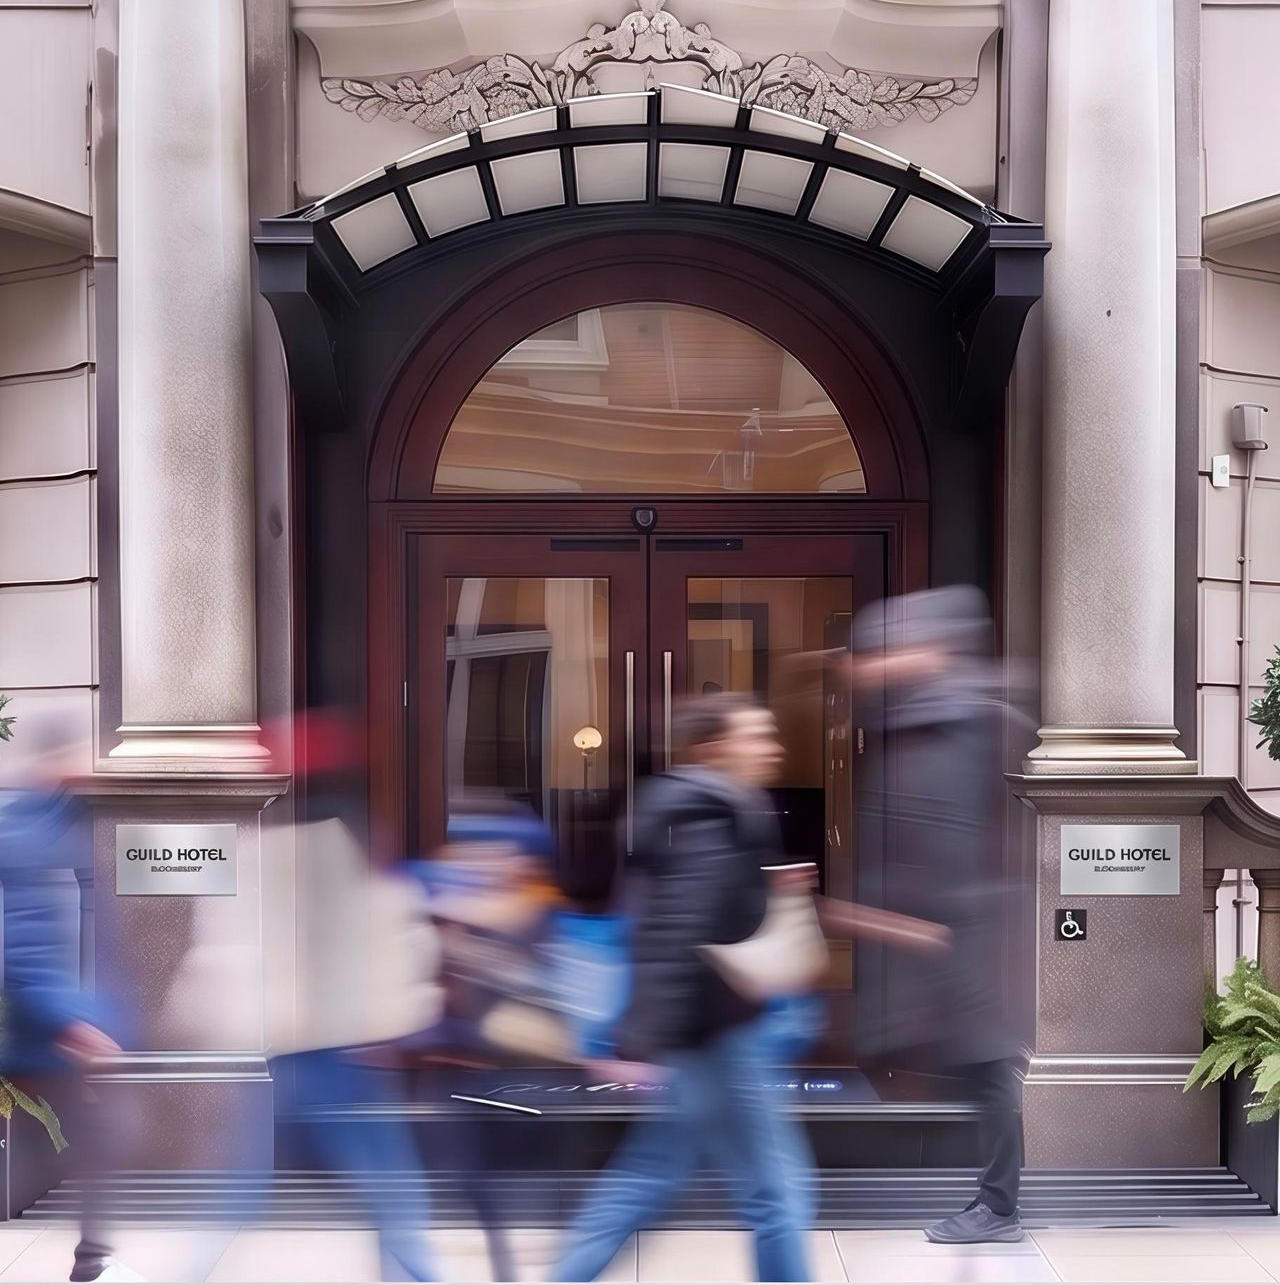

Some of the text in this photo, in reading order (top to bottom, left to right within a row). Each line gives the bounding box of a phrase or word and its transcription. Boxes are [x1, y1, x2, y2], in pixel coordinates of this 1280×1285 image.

[126, 848, 227, 861] GUILD HOTEL
[1068, 848, 1171, 861] GUILD HOTEL
